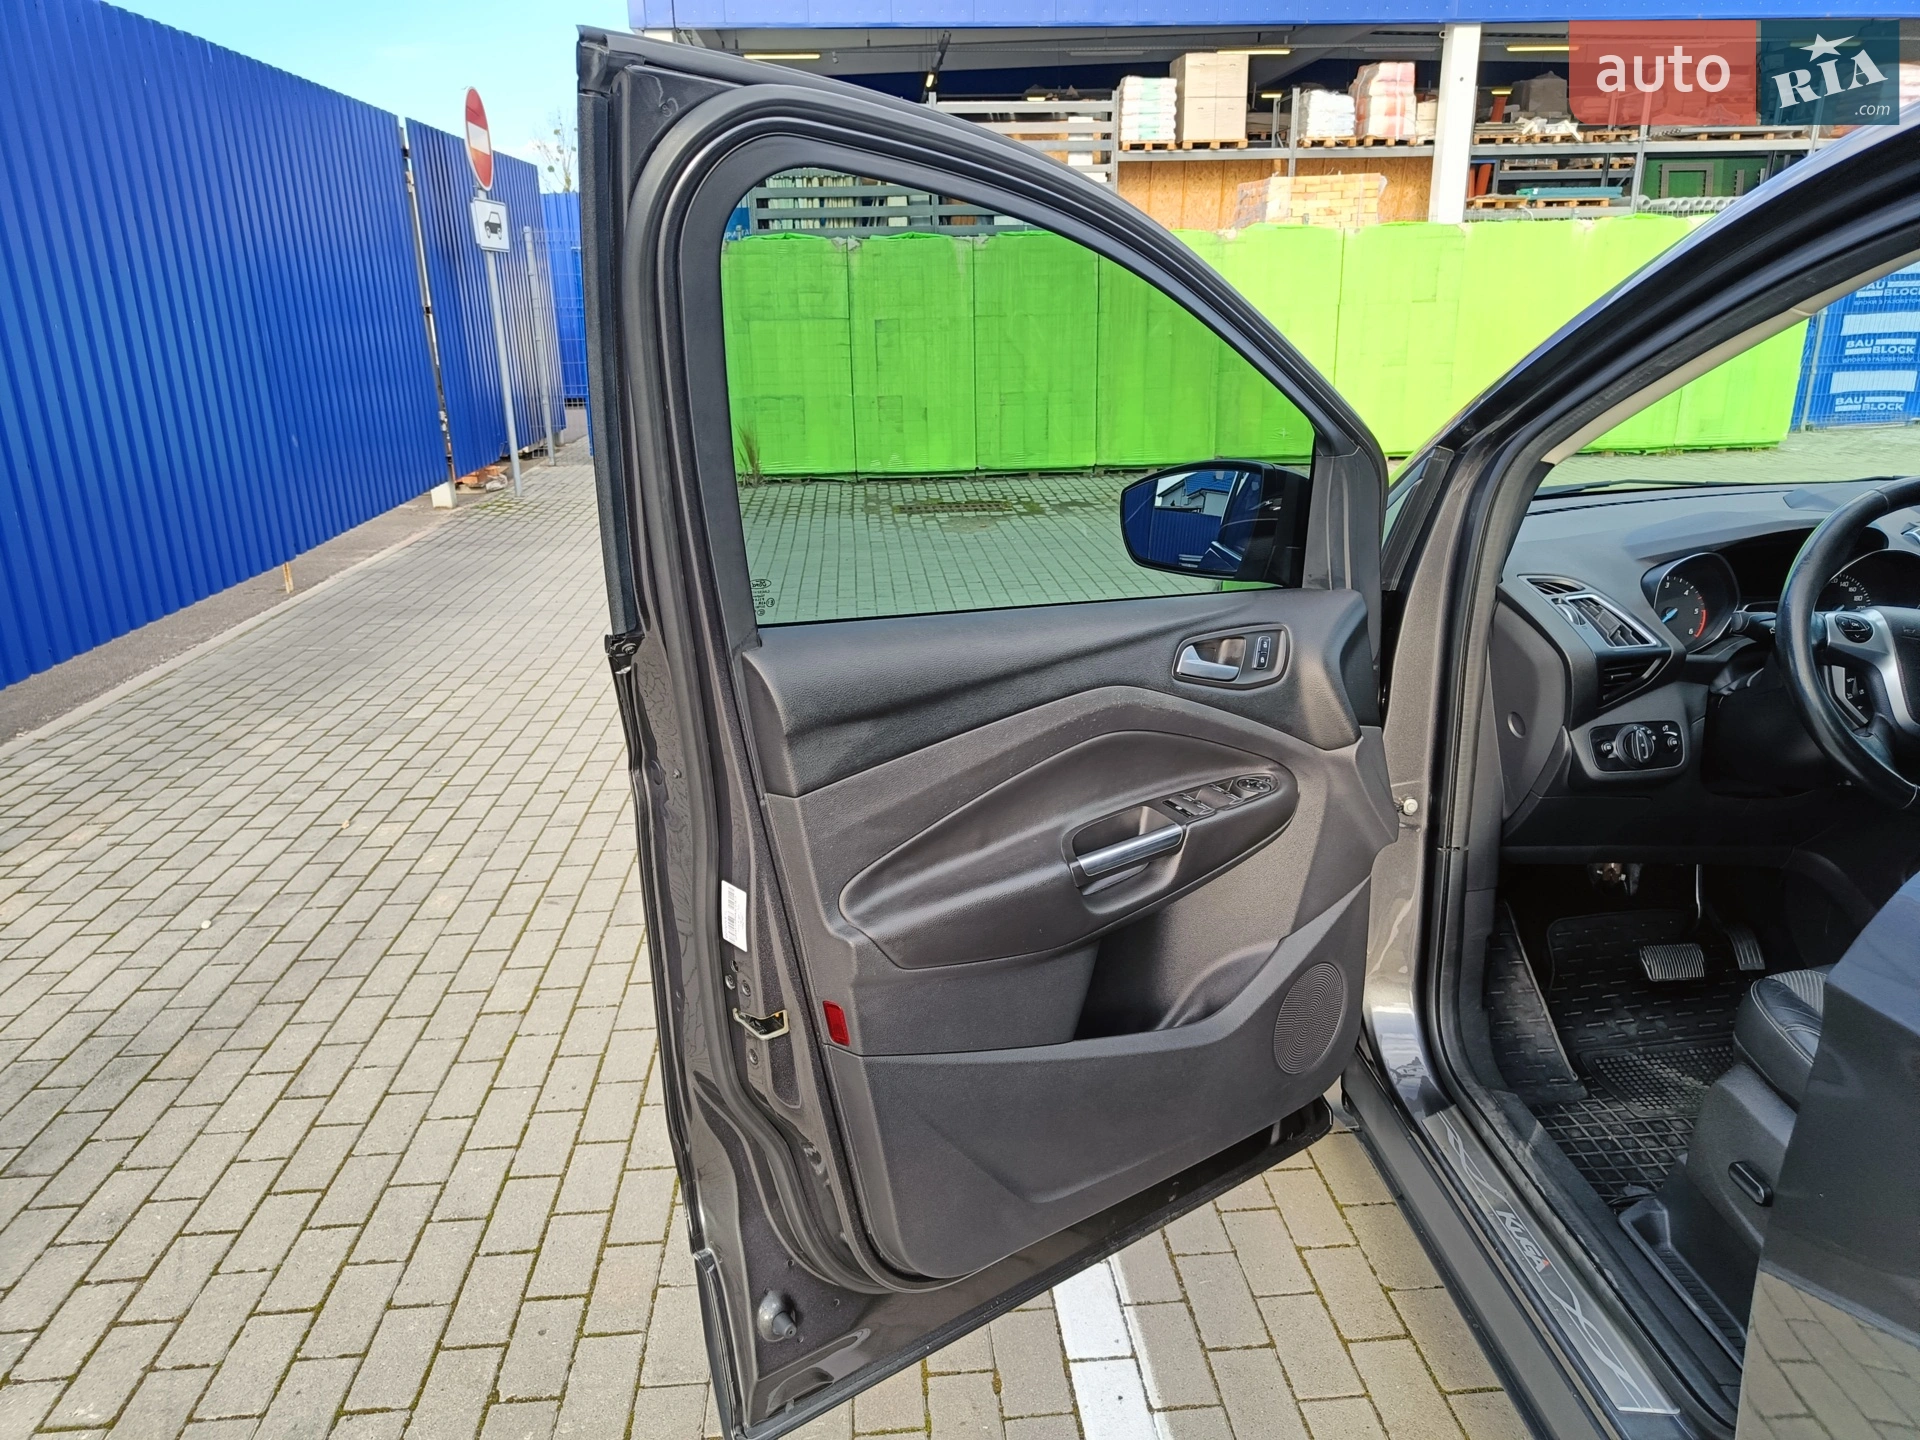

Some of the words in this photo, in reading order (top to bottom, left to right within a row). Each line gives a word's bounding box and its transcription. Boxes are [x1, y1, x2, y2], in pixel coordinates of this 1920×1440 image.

[1884, 287, 1920, 296] BLOC
[1846, 339, 1874, 348] BAU
[1872, 345, 1915, 354] BLOCK
[1835, 396, 1863, 405] BAU
[1862, 402, 1904, 411] BLOCK
[1694, 607, 1699, 615] 5
[1496, 1210, 1550, 1272] KUGA
